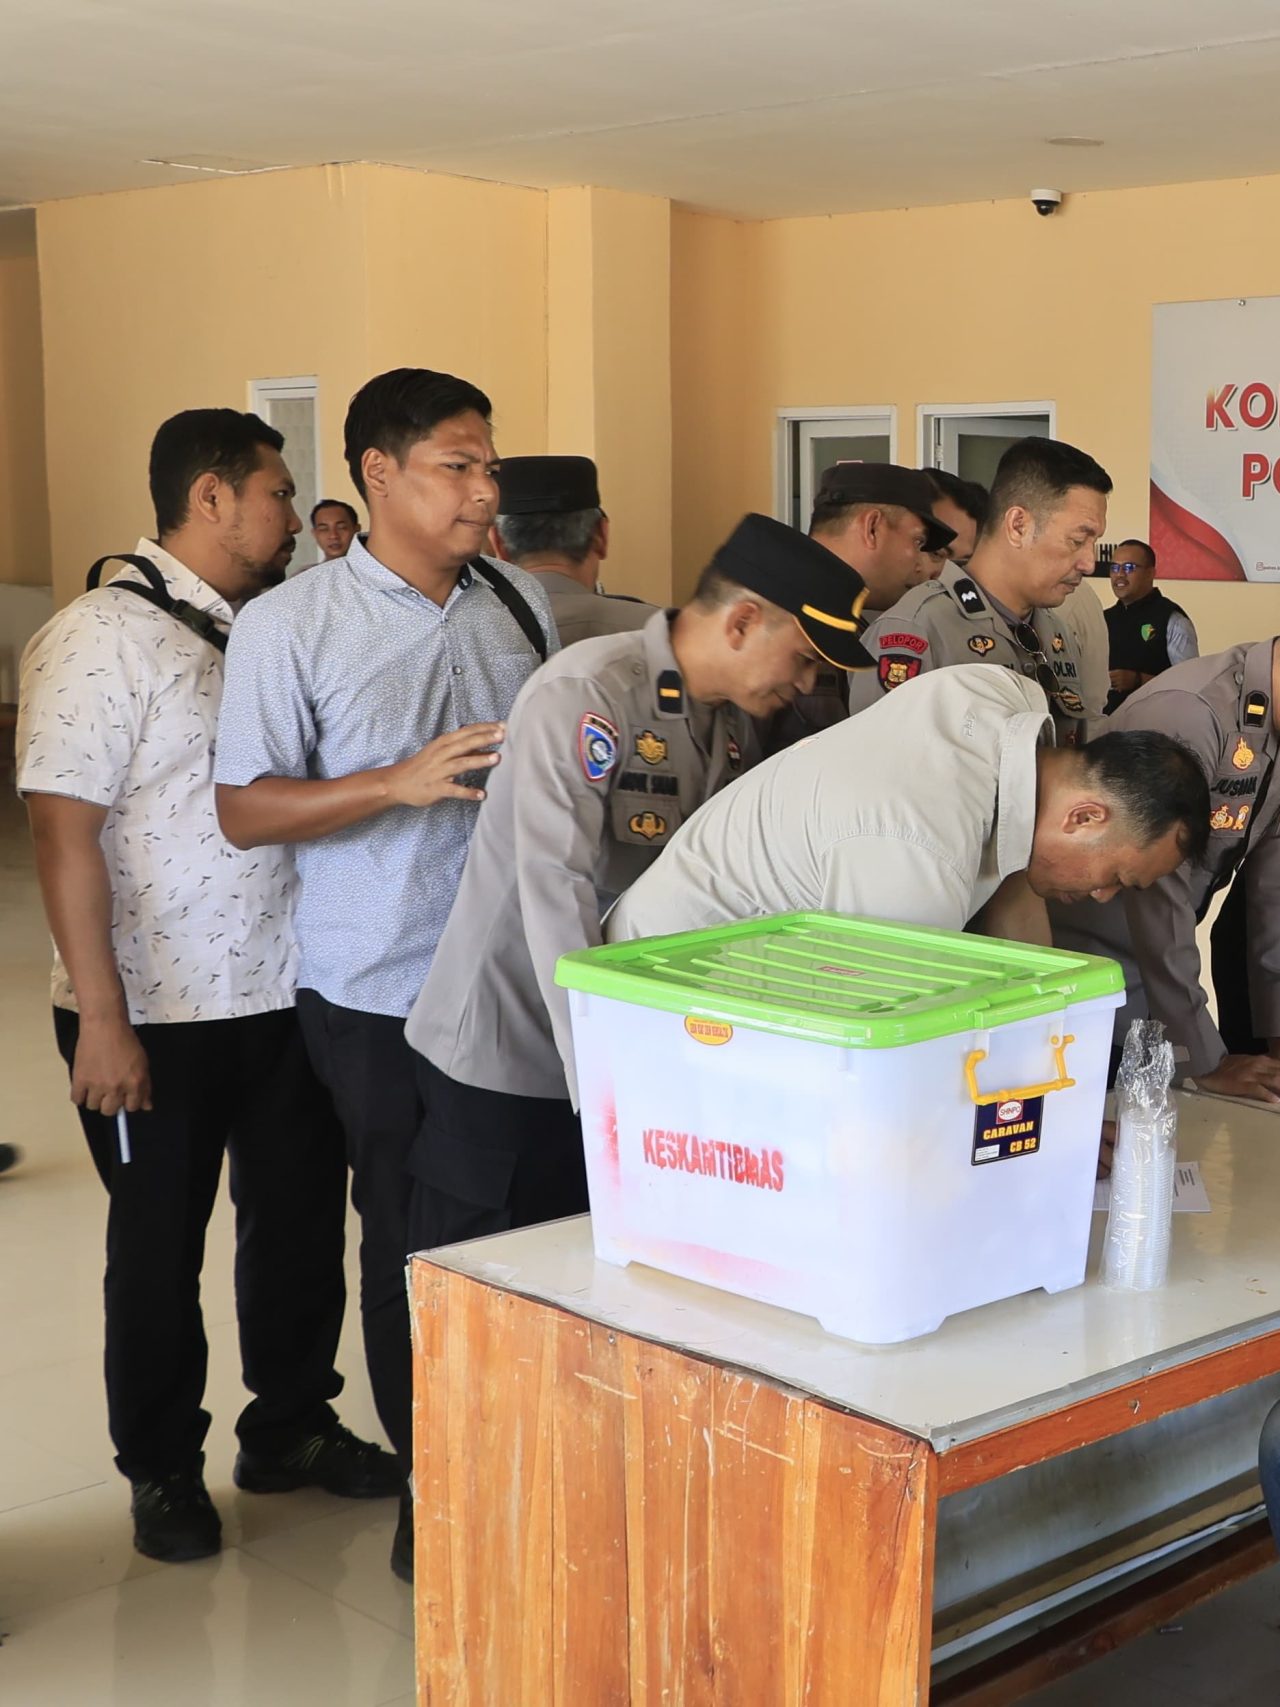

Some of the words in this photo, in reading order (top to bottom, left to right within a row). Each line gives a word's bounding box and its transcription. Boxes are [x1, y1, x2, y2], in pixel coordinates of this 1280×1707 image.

[882, 635, 924, 651] PELOPOR
[1053, 661, 1076, 677] OLRI
[1000, 1105, 1021, 1116] SHINPO
[983, 1121, 1034, 1140] CARAVAN
[1010, 1140, 1023, 1153] CB
[1024, 1137, 1037, 1150] 52
[642, 1128, 785, 1193] KESKAMTIBMAS
